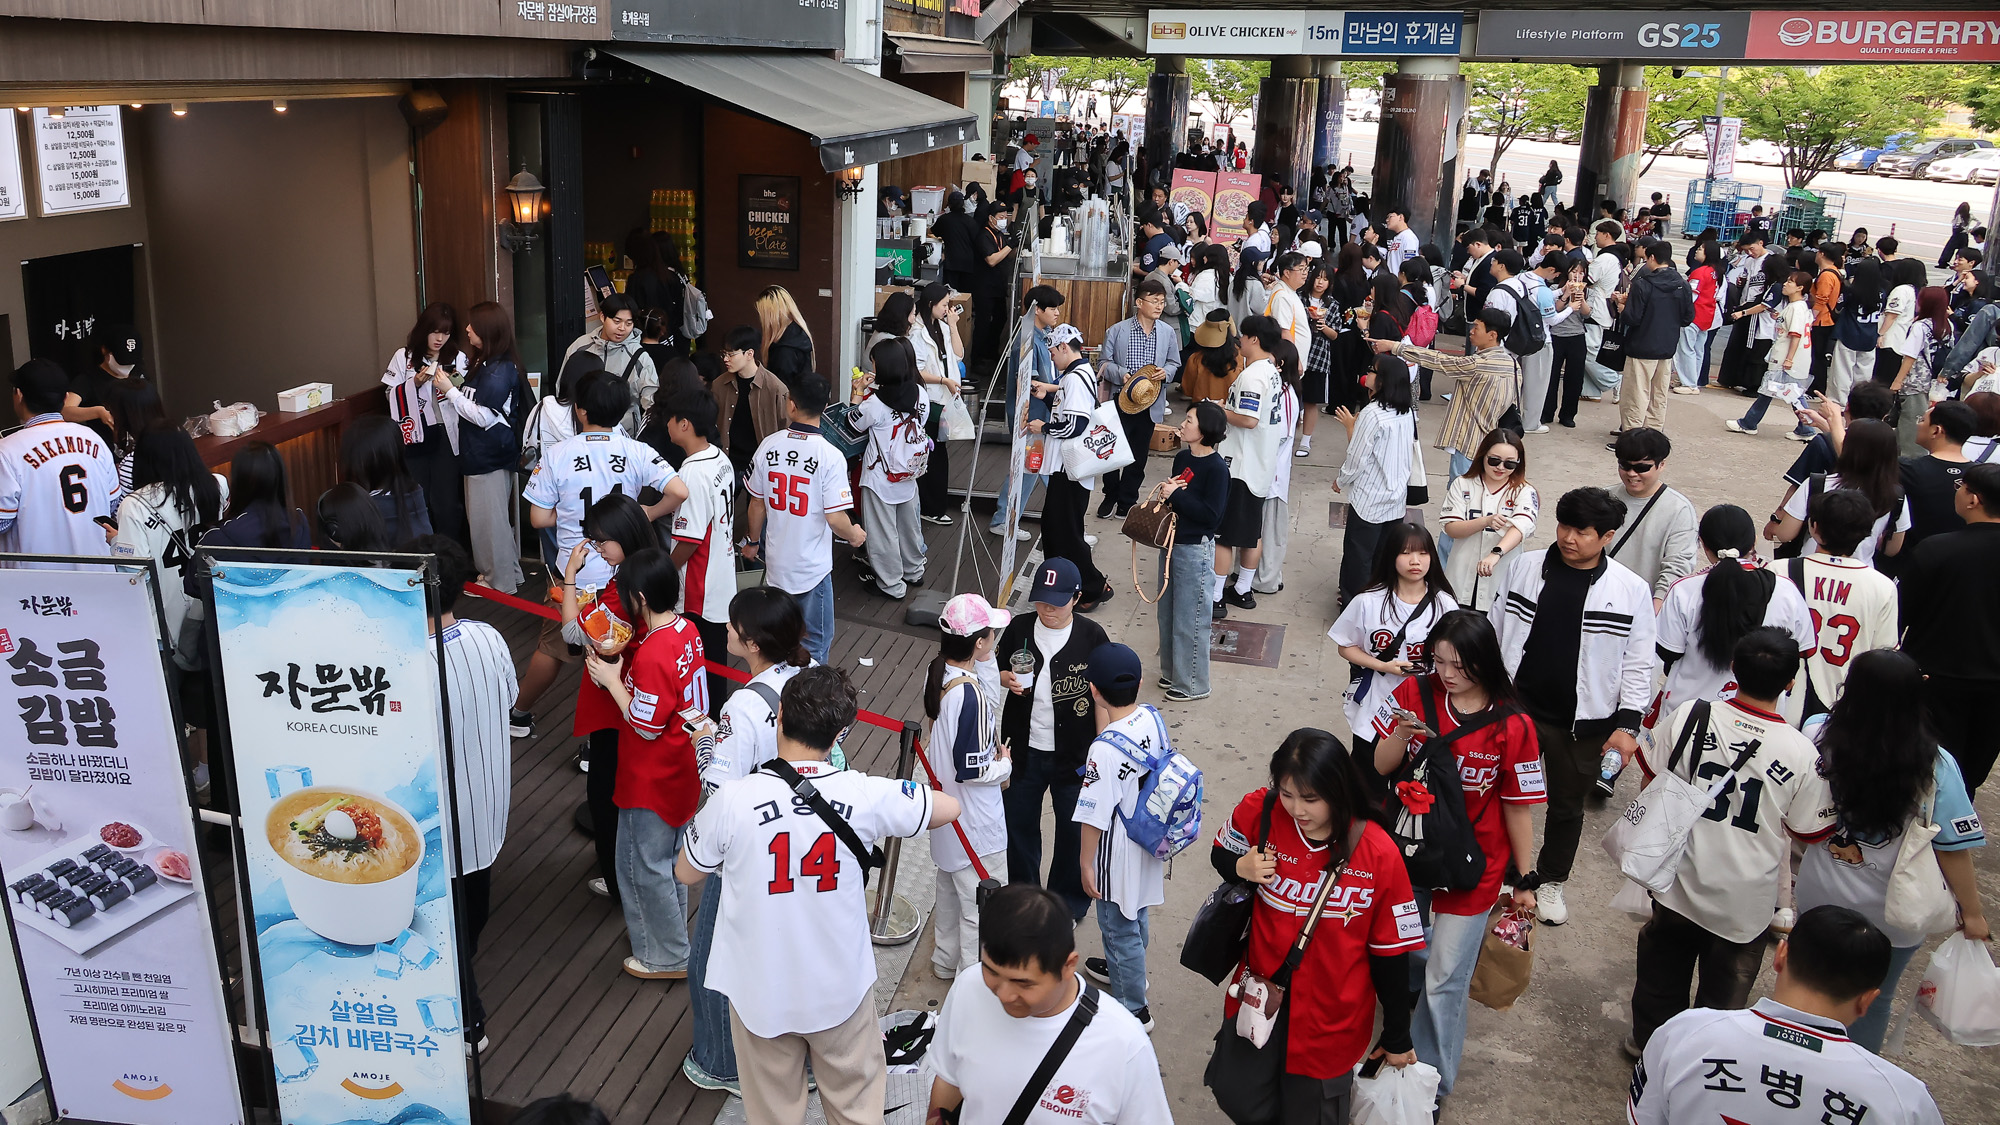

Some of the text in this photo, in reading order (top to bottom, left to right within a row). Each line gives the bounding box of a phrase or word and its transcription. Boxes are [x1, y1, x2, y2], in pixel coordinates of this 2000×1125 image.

[517, 1, 597, 24] 자문밖 잠실야구장점
[621, 10, 650, 27] 휴게음식점
[1190, 25, 1227, 37] OLIVE
[1230, 26, 1285, 38] CHICKEN
[1307, 25, 1340, 41] 15m
[1348, 21, 1457, 45] 만남의 휴게실
[1516, 28, 1625, 41] Lifestyle Platform
[1637, 23, 1721, 48] GS25
[1859, 47, 1893, 55] QUALITY
[1894, 47, 1925, 55] BURGER
[66, 129, 95, 140] 12,500원
[69, 149, 97, 160] 12,500원
[71, 169, 99, 180] 15,000원
[73, 189, 100, 200] 15,000원
[763, 189, 777, 198] bhc
[748, 210, 790, 224] CHICKEN
[1518, 215, 1529, 227] 31
[1534, 213, 1541, 225] 7
[1758, 220, 1770, 230] 39
[754, 236, 787, 251] Plate
[1083, 432, 1118, 450] Bears
[22, 435, 101, 470] SAKAMOTO
[58, 463, 88, 515] 6
[768, 471, 811, 517] 35
[1044, 569, 1058, 587] D
[1814, 576, 1853, 607] KIM
[19, 595, 73, 617] 자문밖
[6, 637, 108, 692] 소금
[255, 662, 391, 717] 자문밖
[17, 693, 119, 749] 김밥
[286, 721, 379, 737] KOREA CUISINE
[26, 752, 76, 767] 소금하나
[29, 767, 132, 786] 김밥이 달라졌어요
[1697, 761, 1763, 834] 31
[768, 831, 841, 895] 14
[64, 967, 81, 979] 7년
[83, 968, 101, 980] 이상
[103, 969, 130, 981] 간수를
[144, 973, 172, 984] 천일염
[73, 984, 169, 1000] 고시히까리 프리미엄 쌀
[83, 1000, 167, 1017] 프리미엄 야끼노리김
[329, 1000, 398, 1027] 살얼음
[69, 1015, 187, 1034] 저염 명란으로 완성된 깊은 맛
[294, 1023, 440, 1058] 김치 바람국수
[1776, 1030, 1810, 1046] JOSUN
[123, 1072, 160, 1083] AMOJE
[352, 1071, 391, 1082] AMOJE
[1039, 1099, 1084, 1119] EBONITE
